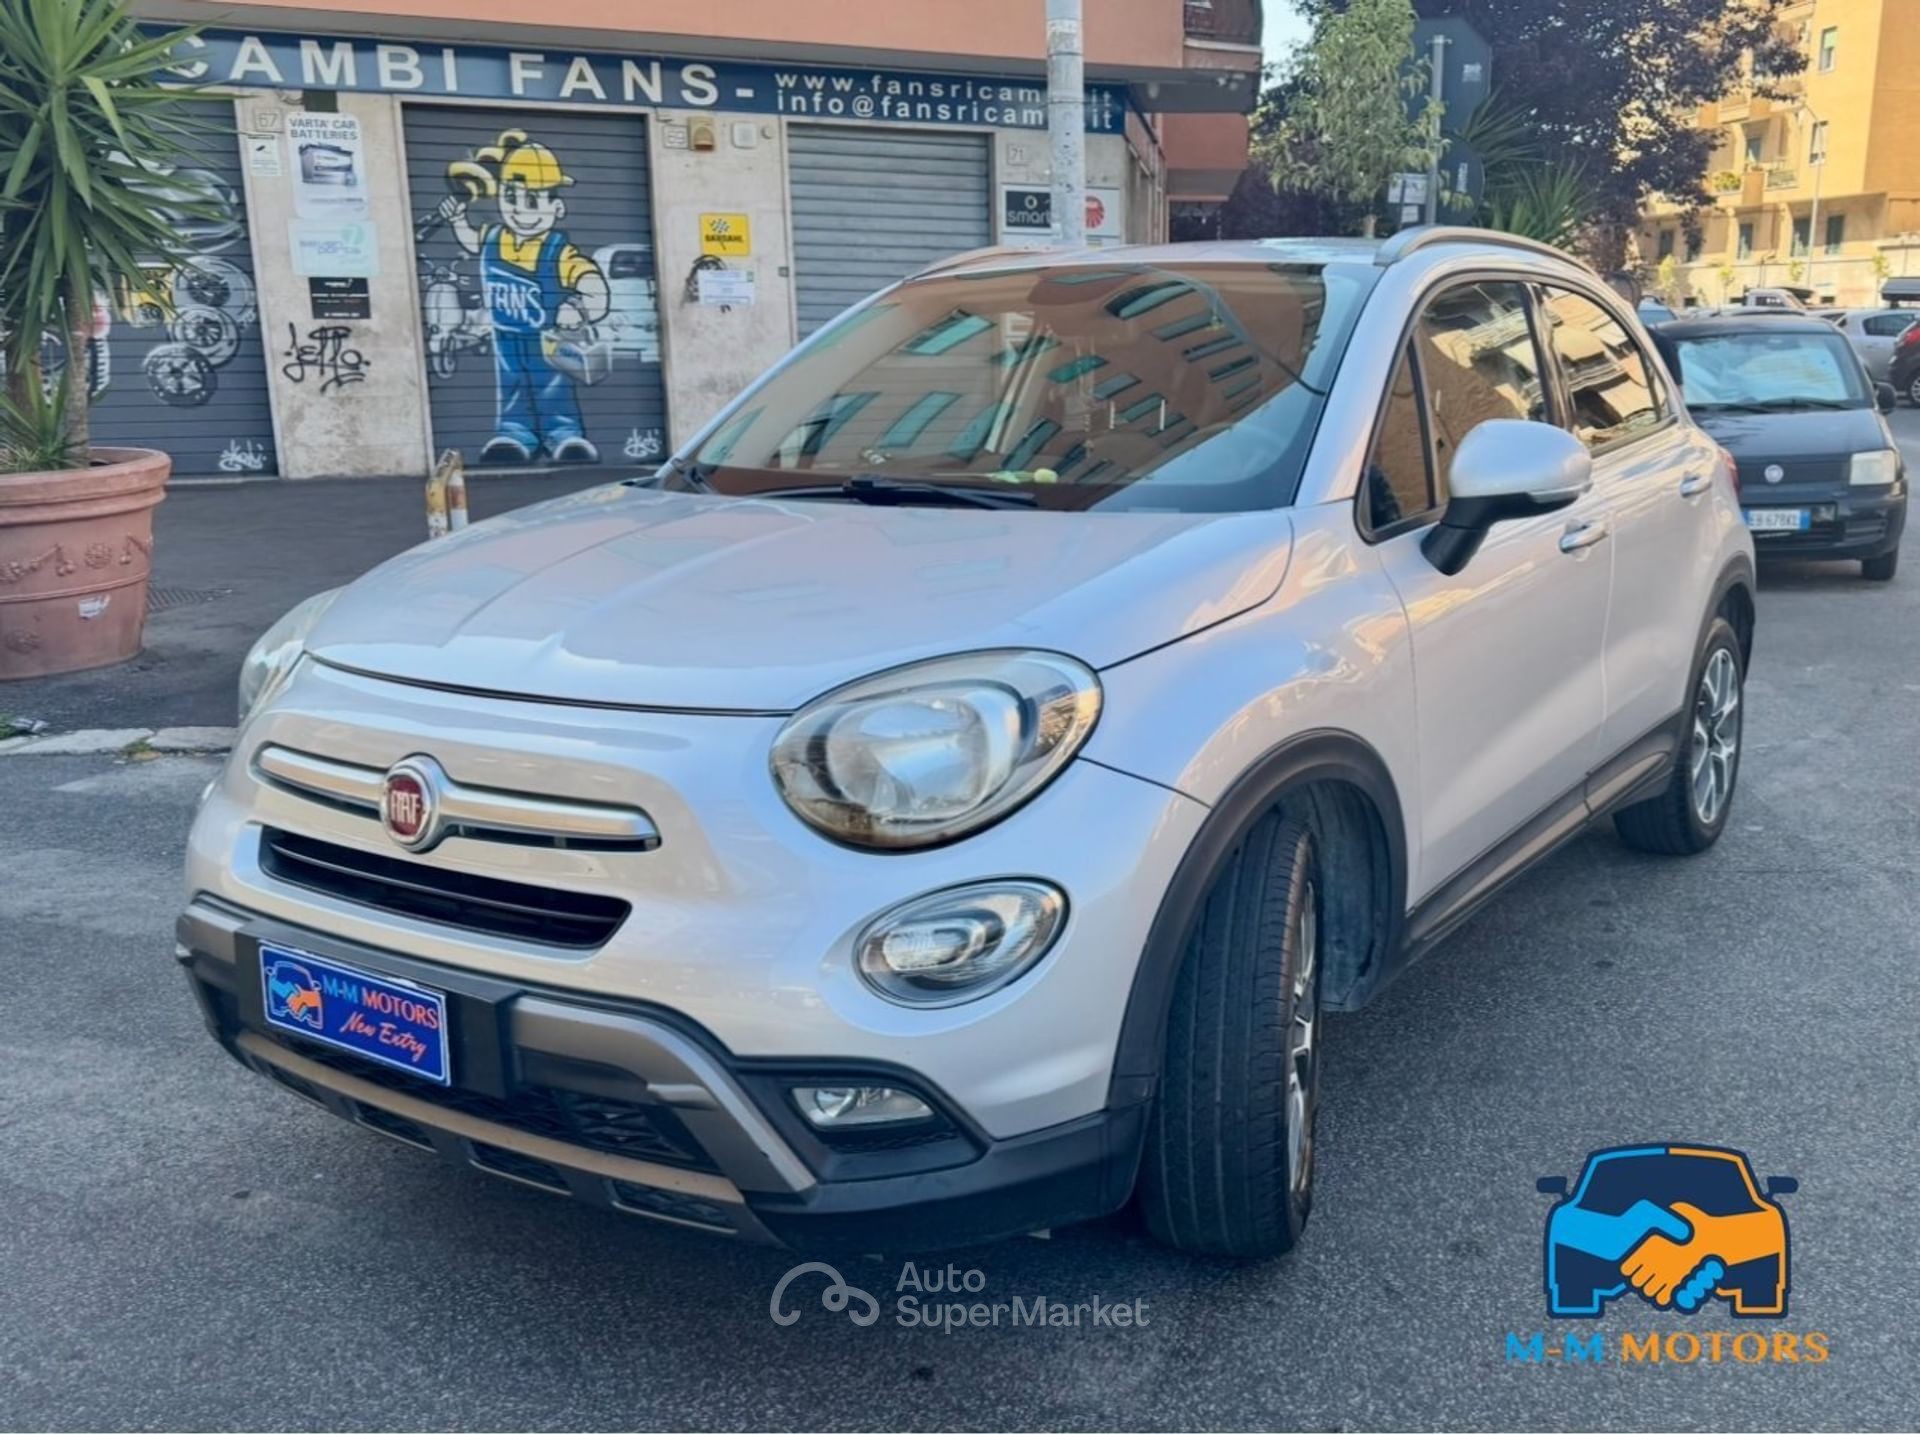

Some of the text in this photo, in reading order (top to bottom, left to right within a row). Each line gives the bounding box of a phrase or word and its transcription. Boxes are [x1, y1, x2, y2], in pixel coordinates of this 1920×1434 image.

[113, 33, 459, 93] CAMBI
[774, 73, 1112, 108] www.fansricamit
[332, 120, 356, 129] CAR
[777, 89, 1112, 130] info@fansricamit
[290, 130, 358, 140] BATTERIES
[391, 789, 421, 825] FIAT
[322, 975, 439, 1030] M-M MOTORS
[339, 1011, 427, 1062] New Entry
